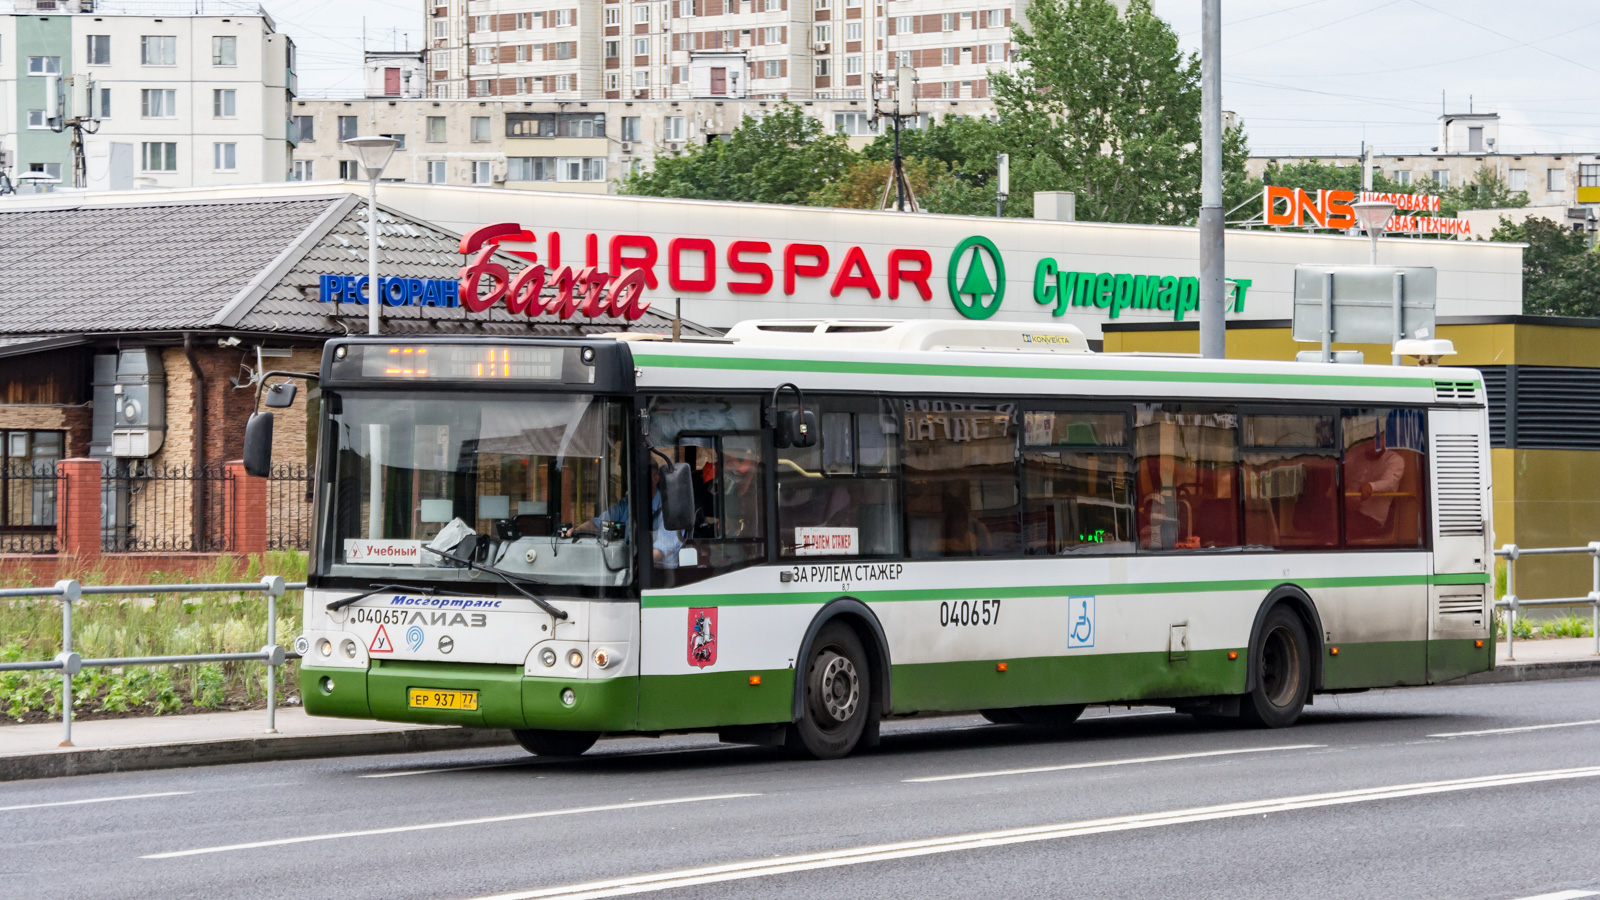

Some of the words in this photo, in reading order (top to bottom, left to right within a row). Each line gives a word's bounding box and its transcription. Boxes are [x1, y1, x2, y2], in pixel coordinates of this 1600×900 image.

[1264, 185, 1355, 229] DNS
[1431, 195, 1440, 212] И
[1420, 216, 1471, 234] ТЕХНИКА
[319, 274, 459, 308] РЕСТОРАН
[1034, 257, 1252, 321] Супермарт
[1031, 334, 1070, 344] KONVEKTA
[831, 534, 852, 550] СТАЖЕР
[366, 545, 417, 557] Учебный
[793, 566, 809, 582] ЗА
[811, 565, 853, 583] РУЛЕМ
[855, 563, 903, 581] СТАЖЕР
[390, 595, 502, 609] Мосгортранс
[357, 608, 409, 625] 040657
[407, 611, 487, 628] ЛИАЗ
[940, 599, 1001, 627] 040657
[415, 694, 429, 706] ЕР
[434, 692, 455, 708] 937
[461, 693, 474, 705] 77
